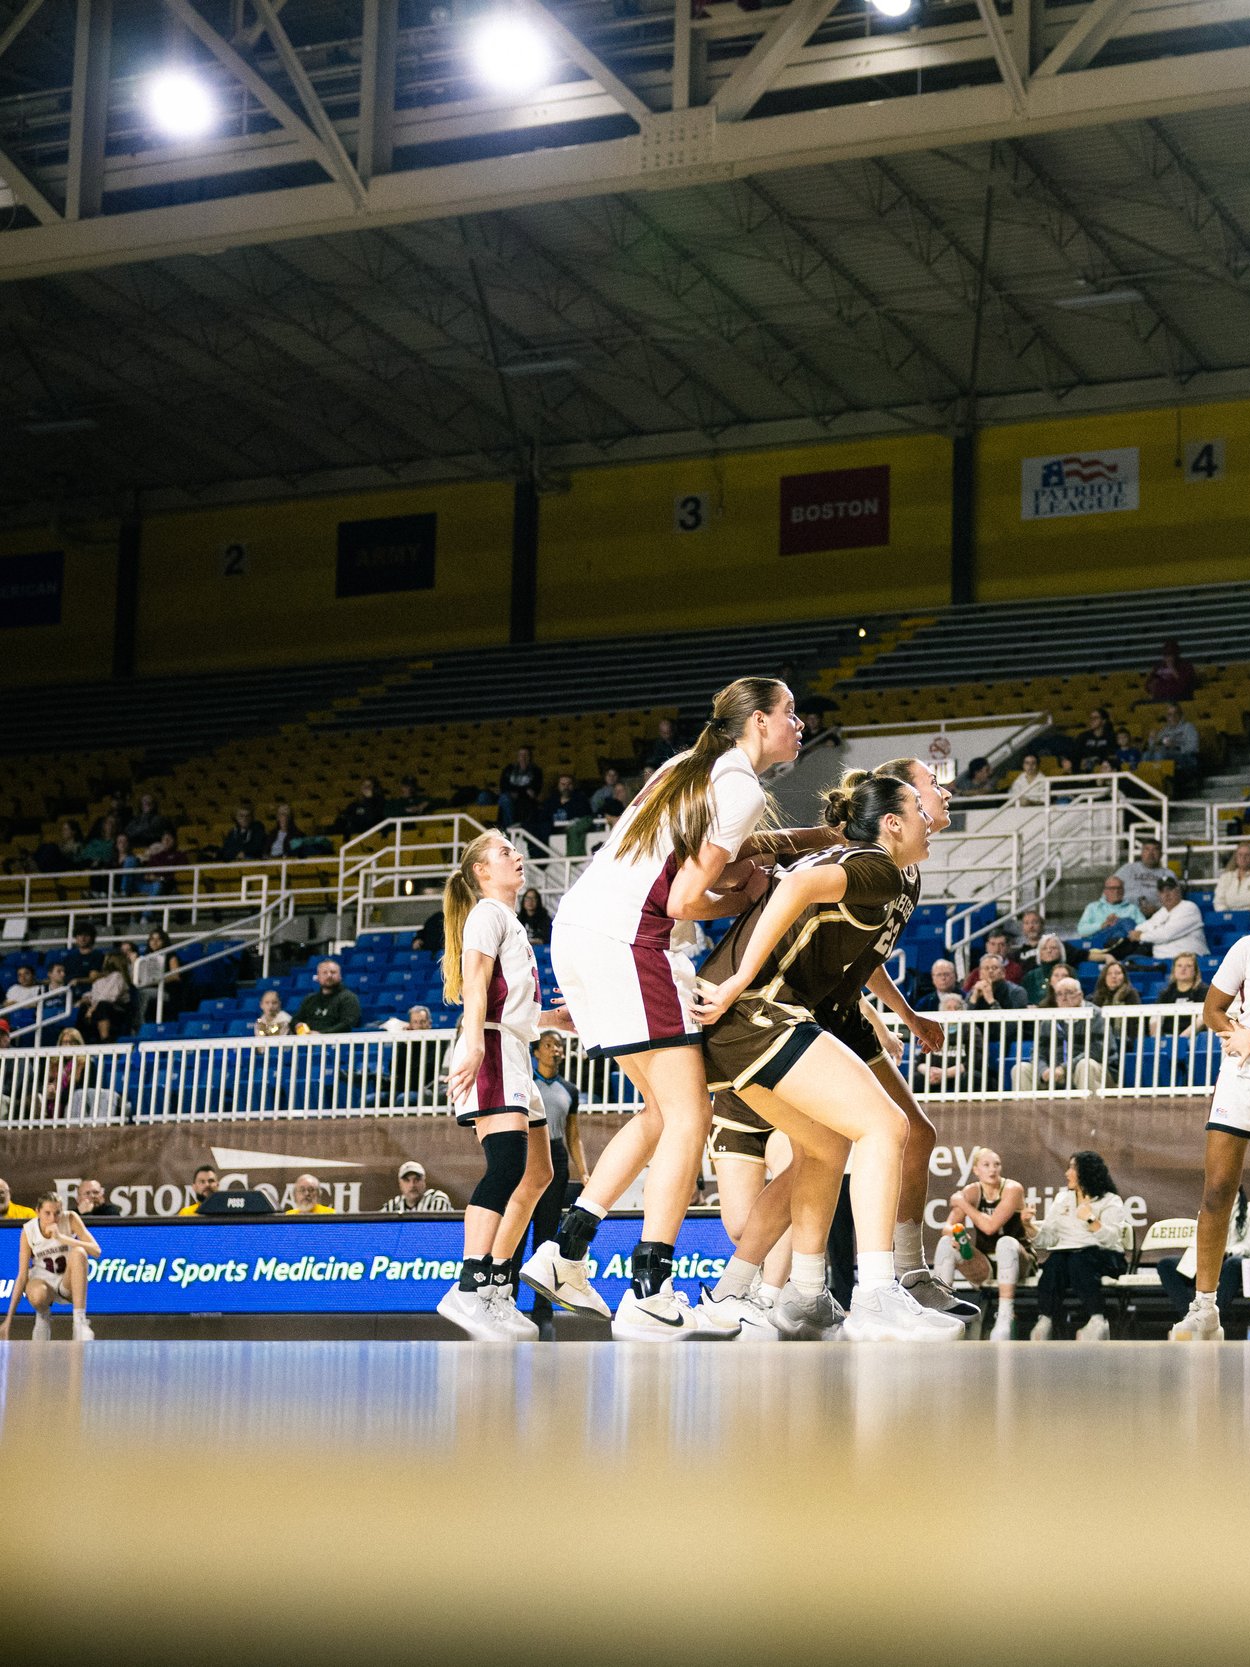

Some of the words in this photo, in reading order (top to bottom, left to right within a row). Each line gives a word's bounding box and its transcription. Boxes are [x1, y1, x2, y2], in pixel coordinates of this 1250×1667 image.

[1190, 444, 1217, 478] 4
[1033, 481, 1128, 503] PATRIOT
[1033, 497, 1125, 516] LEAGUE
[679, 495, 702, 530] 3
[790, 497, 880, 523] BOSTON
[223, 544, 246, 576] 2
[87, 1257, 167, 1283] Official
[168, 1257, 249, 1289] Sports
[252, 1256, 364, 1282] Medicine
[369, 1255, 464, 1281] Partner
[602, 1252, 726, 1279] Atetics
